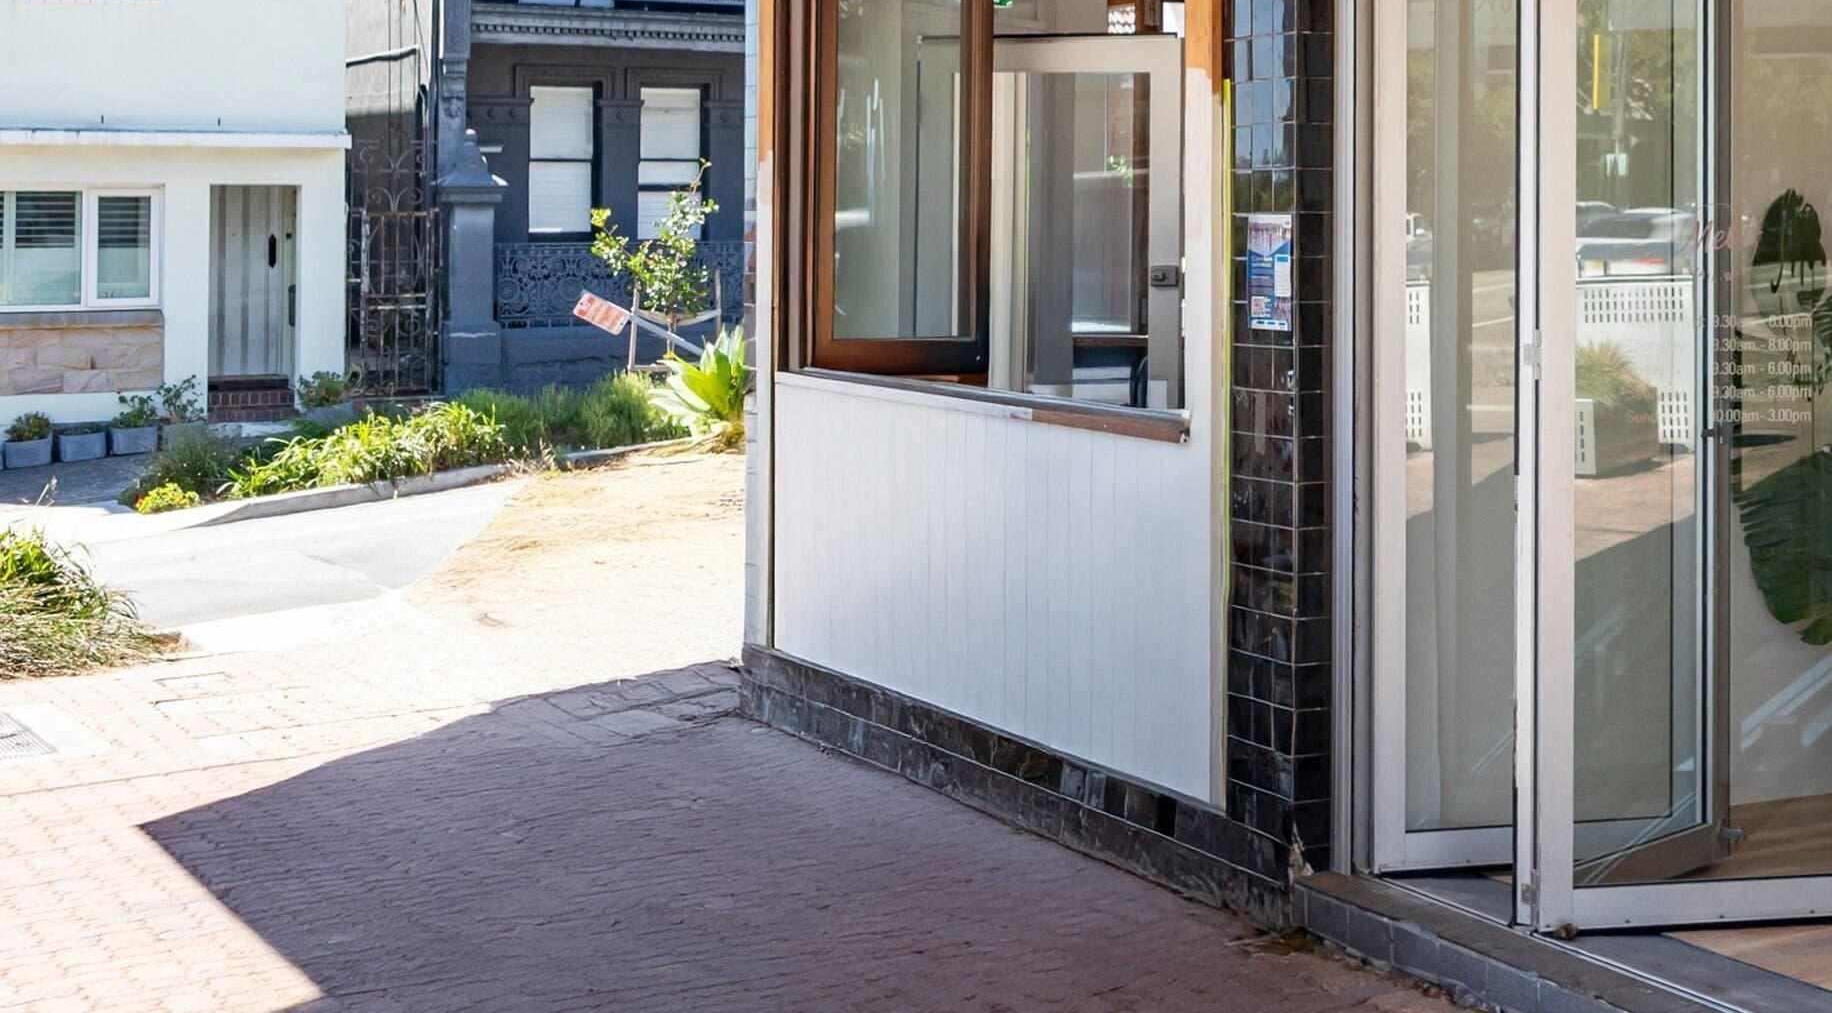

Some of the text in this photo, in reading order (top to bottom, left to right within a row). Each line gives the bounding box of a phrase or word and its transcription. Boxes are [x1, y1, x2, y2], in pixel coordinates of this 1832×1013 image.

[1713, 315, 1754, 328] 9.30a
[1768, 338, 1812, 354] 8.00pm
[1768, 362, 1811, 378] 6.00pm
[1768, 385, 1811, 401] 6.00pm
[1768, 408, 1811, 424] 3.00pm
